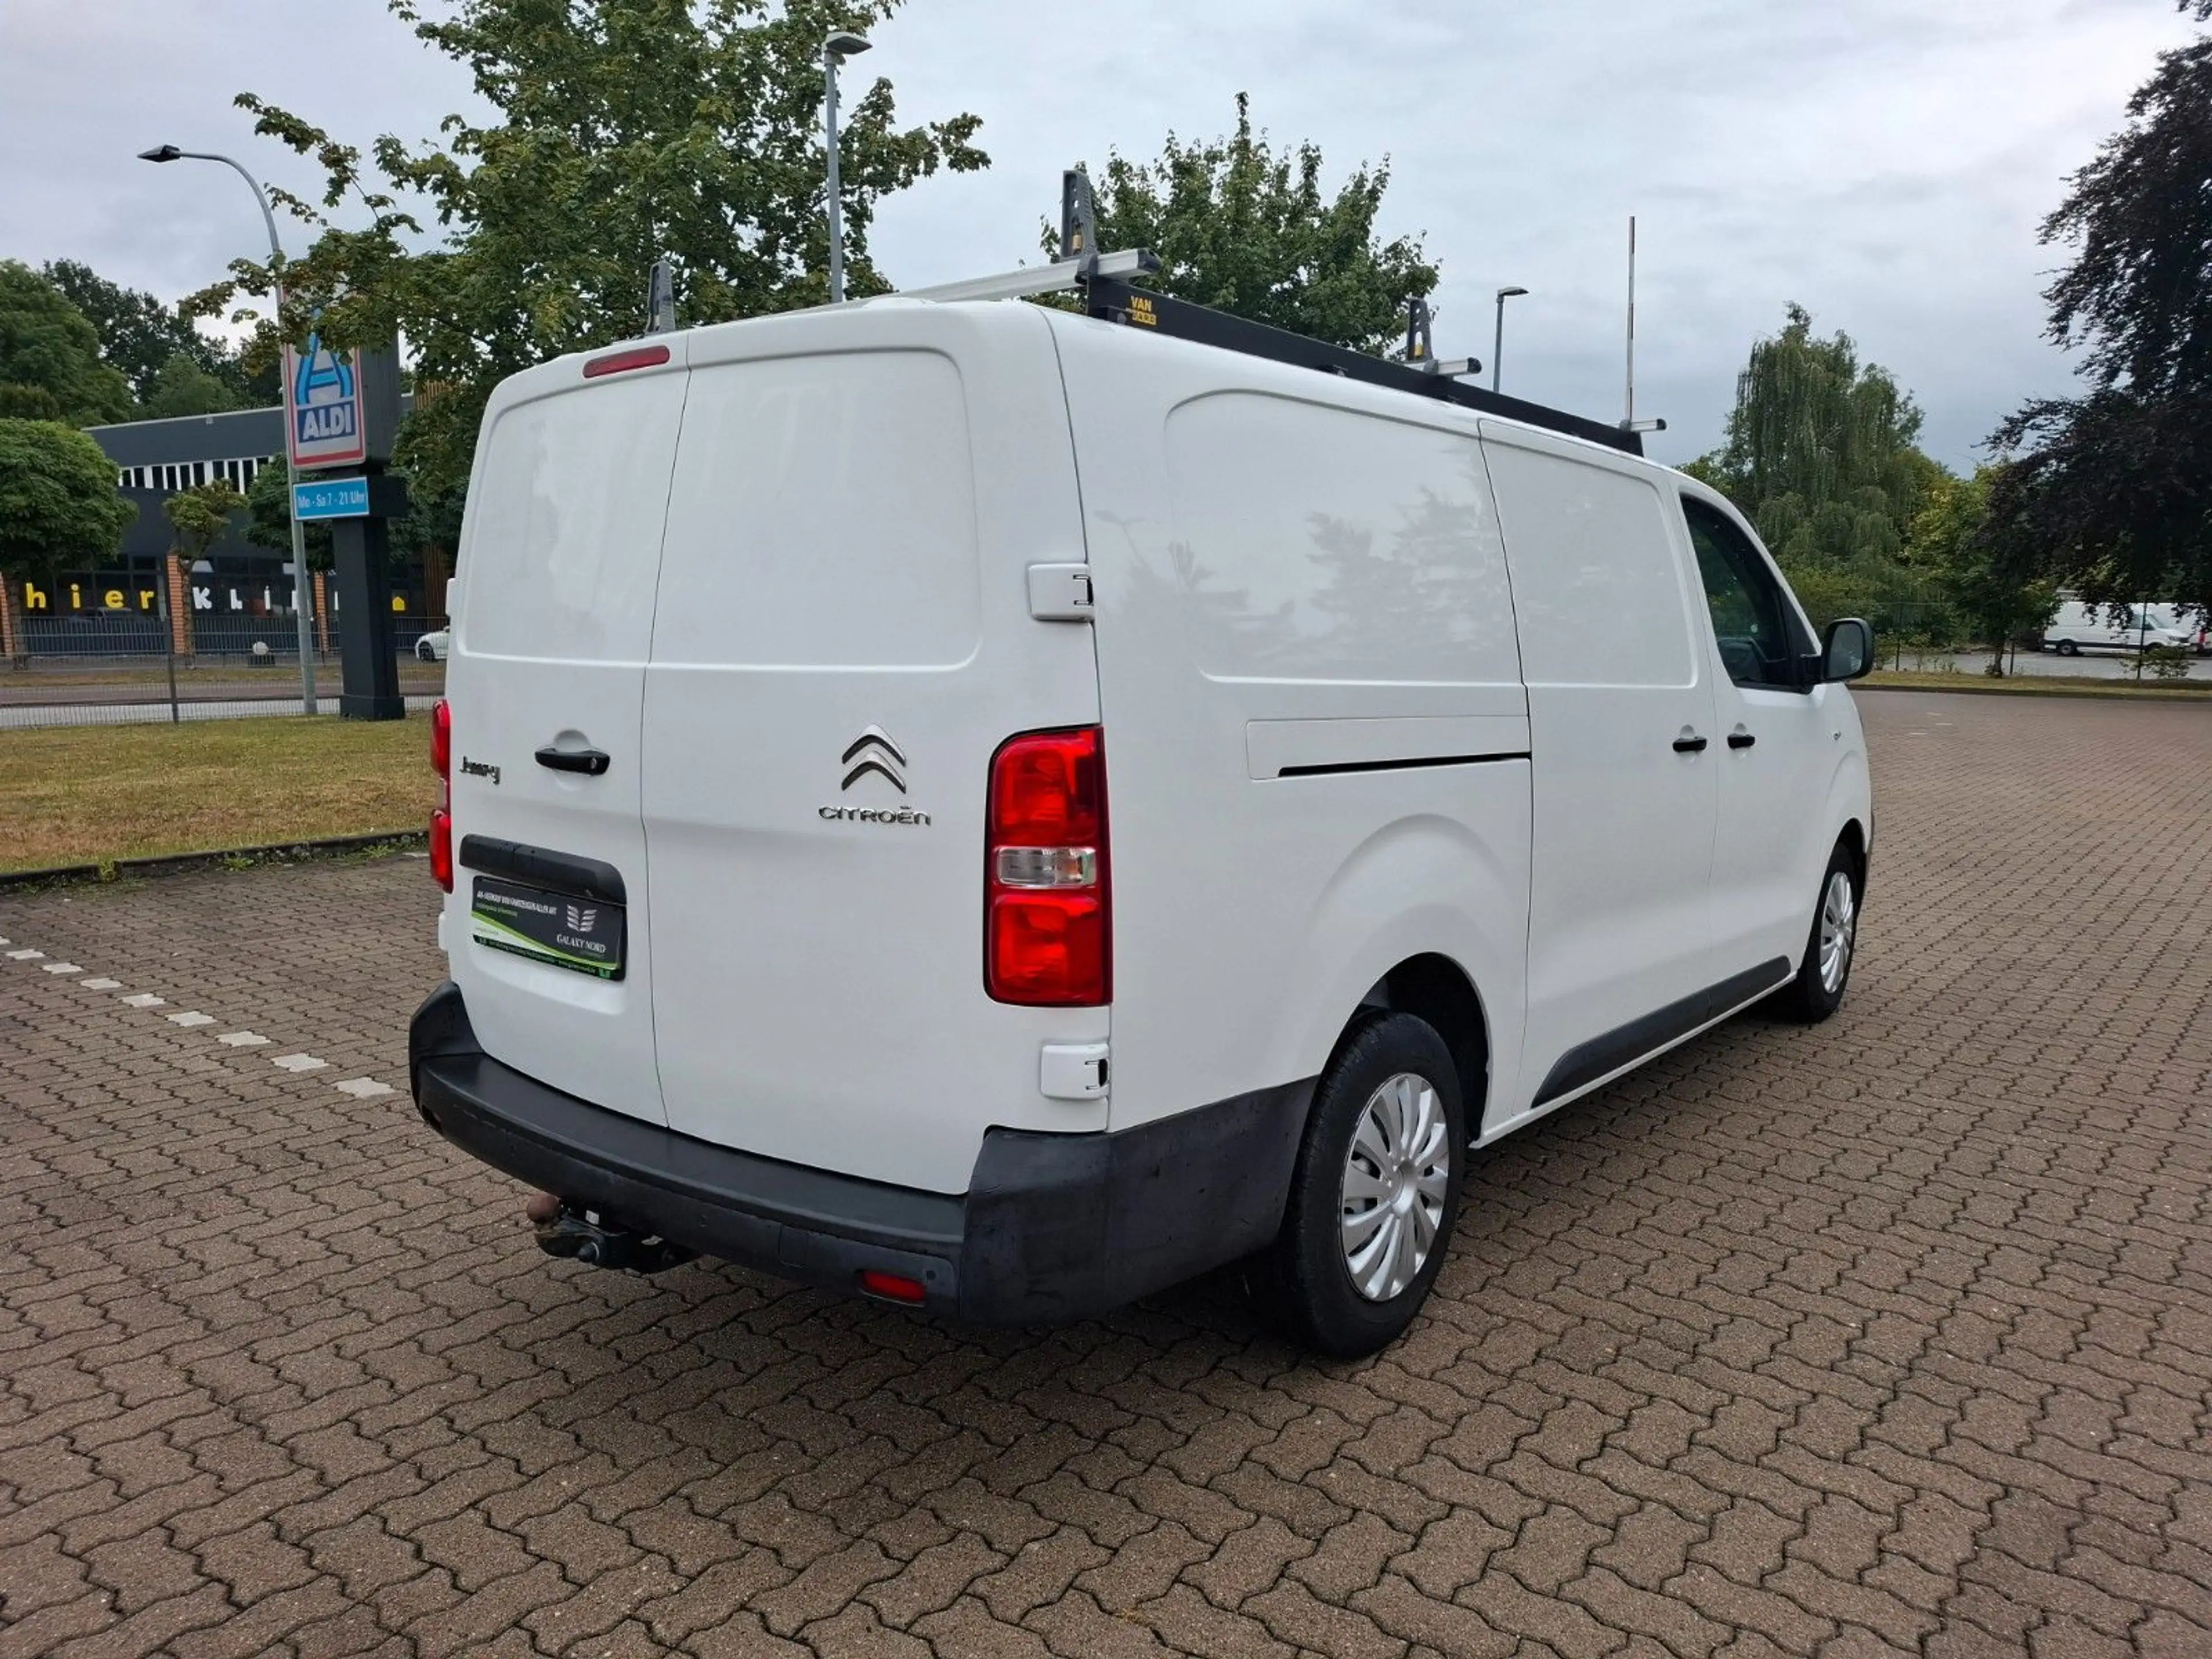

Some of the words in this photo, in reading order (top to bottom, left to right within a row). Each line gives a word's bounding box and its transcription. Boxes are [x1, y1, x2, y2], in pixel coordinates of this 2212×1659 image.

[1131, 295, 1152, 312] VAN
[302, 404, 352, 440] ALDI
[339, 491, 348, 505] 21
[350, 490, 365, 504] Uhr
[26, 582, 154, 609] hier
